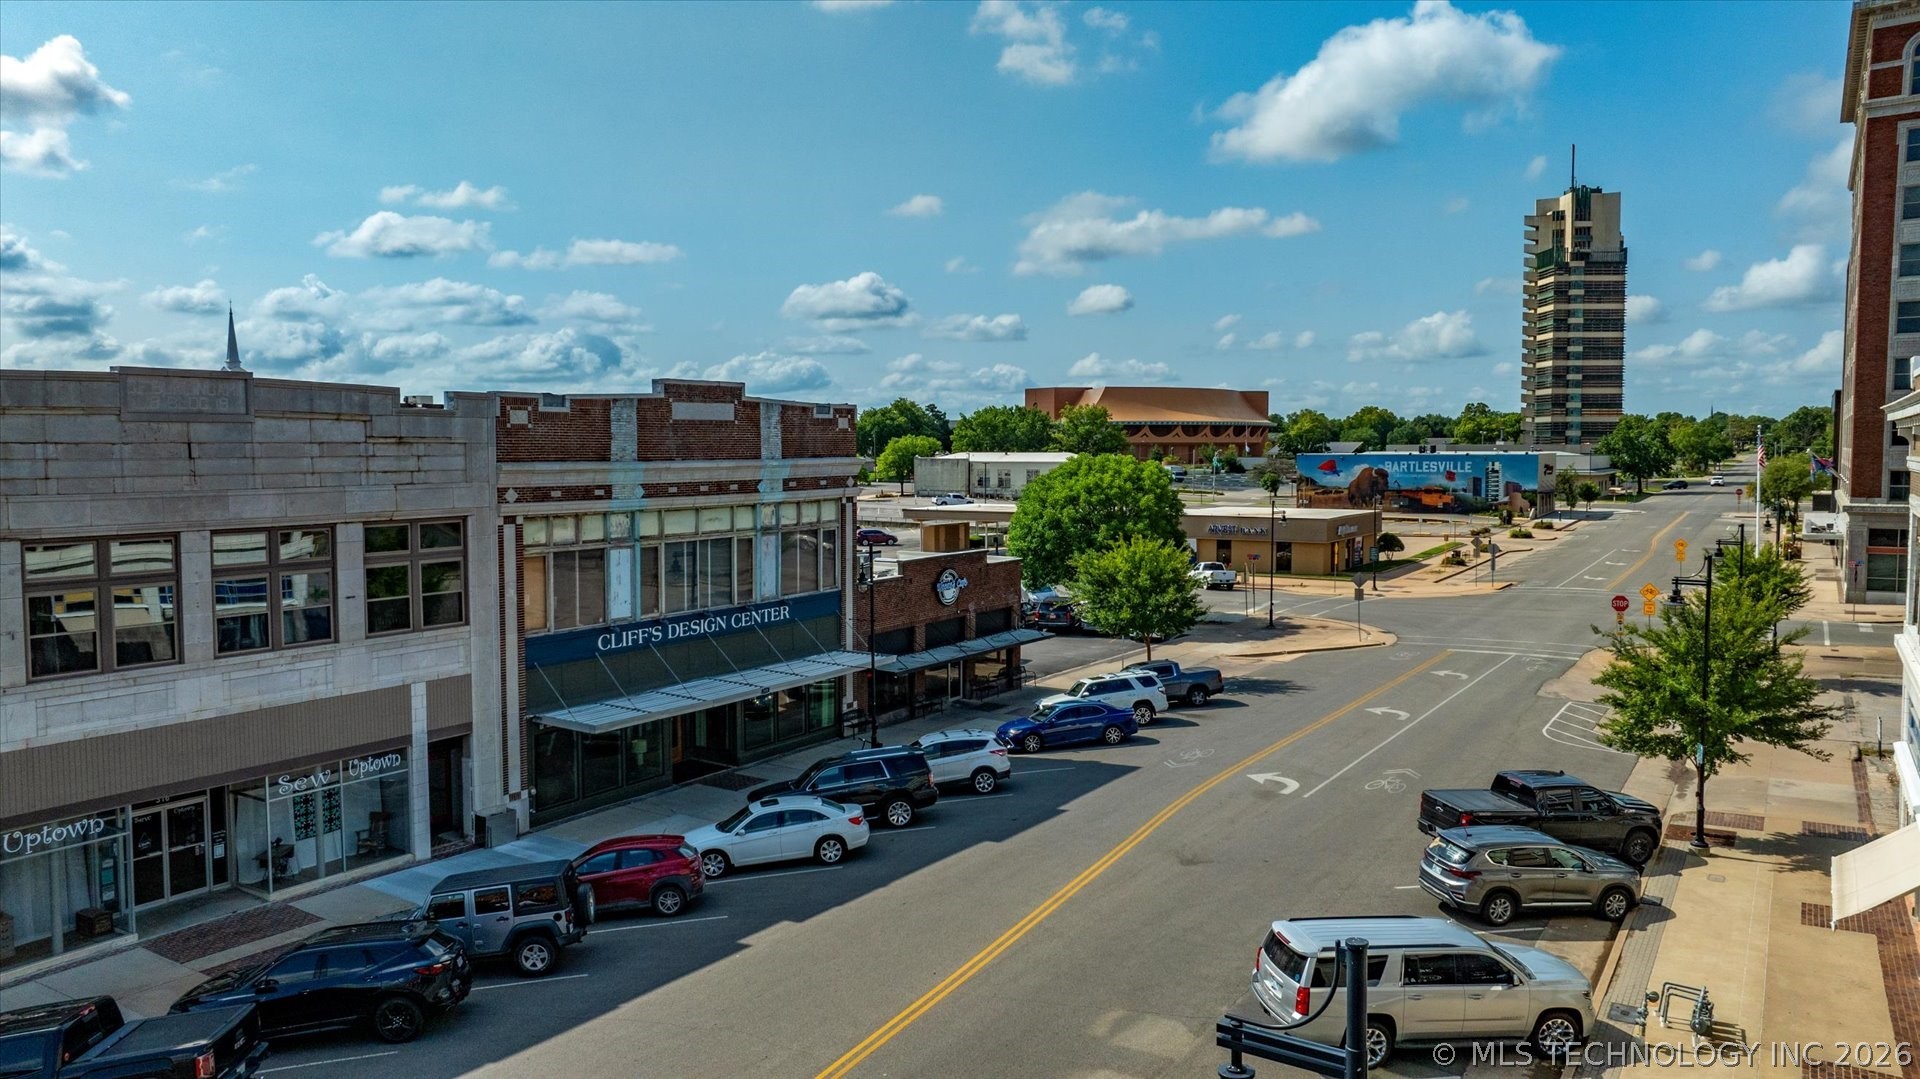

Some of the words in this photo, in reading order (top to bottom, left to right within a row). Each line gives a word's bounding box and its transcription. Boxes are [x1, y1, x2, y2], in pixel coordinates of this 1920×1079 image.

[1384, 461, 1472, 473] BARTLESVILLE
[597, 626, 663, 650] CLIFF'S
[667, 615, 727, 639] DESIGN
[731, 605, 790, 629] CENTER
[278, 769, 331, 795] Sew
[348, 753, 401, 778] Uptown
[3, 818, 105, 855] Uptown
